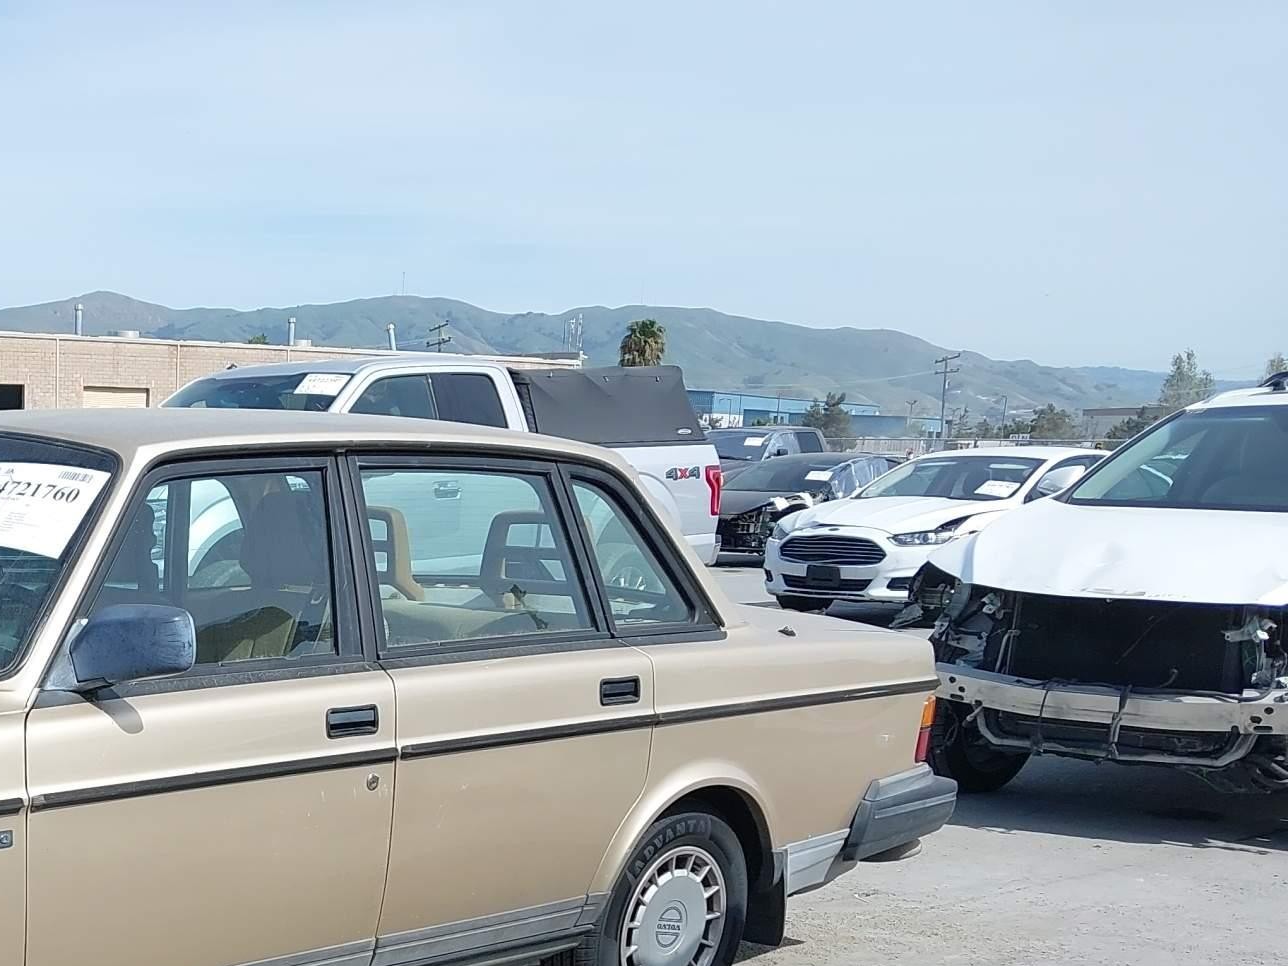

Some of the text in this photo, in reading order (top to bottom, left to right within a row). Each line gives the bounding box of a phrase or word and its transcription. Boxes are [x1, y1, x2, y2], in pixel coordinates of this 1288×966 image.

[665, 466, 700, 480] 4x4
[635, 819, 706, 874] ADVANTA
[656, 923, 681, 931] VOLVO
